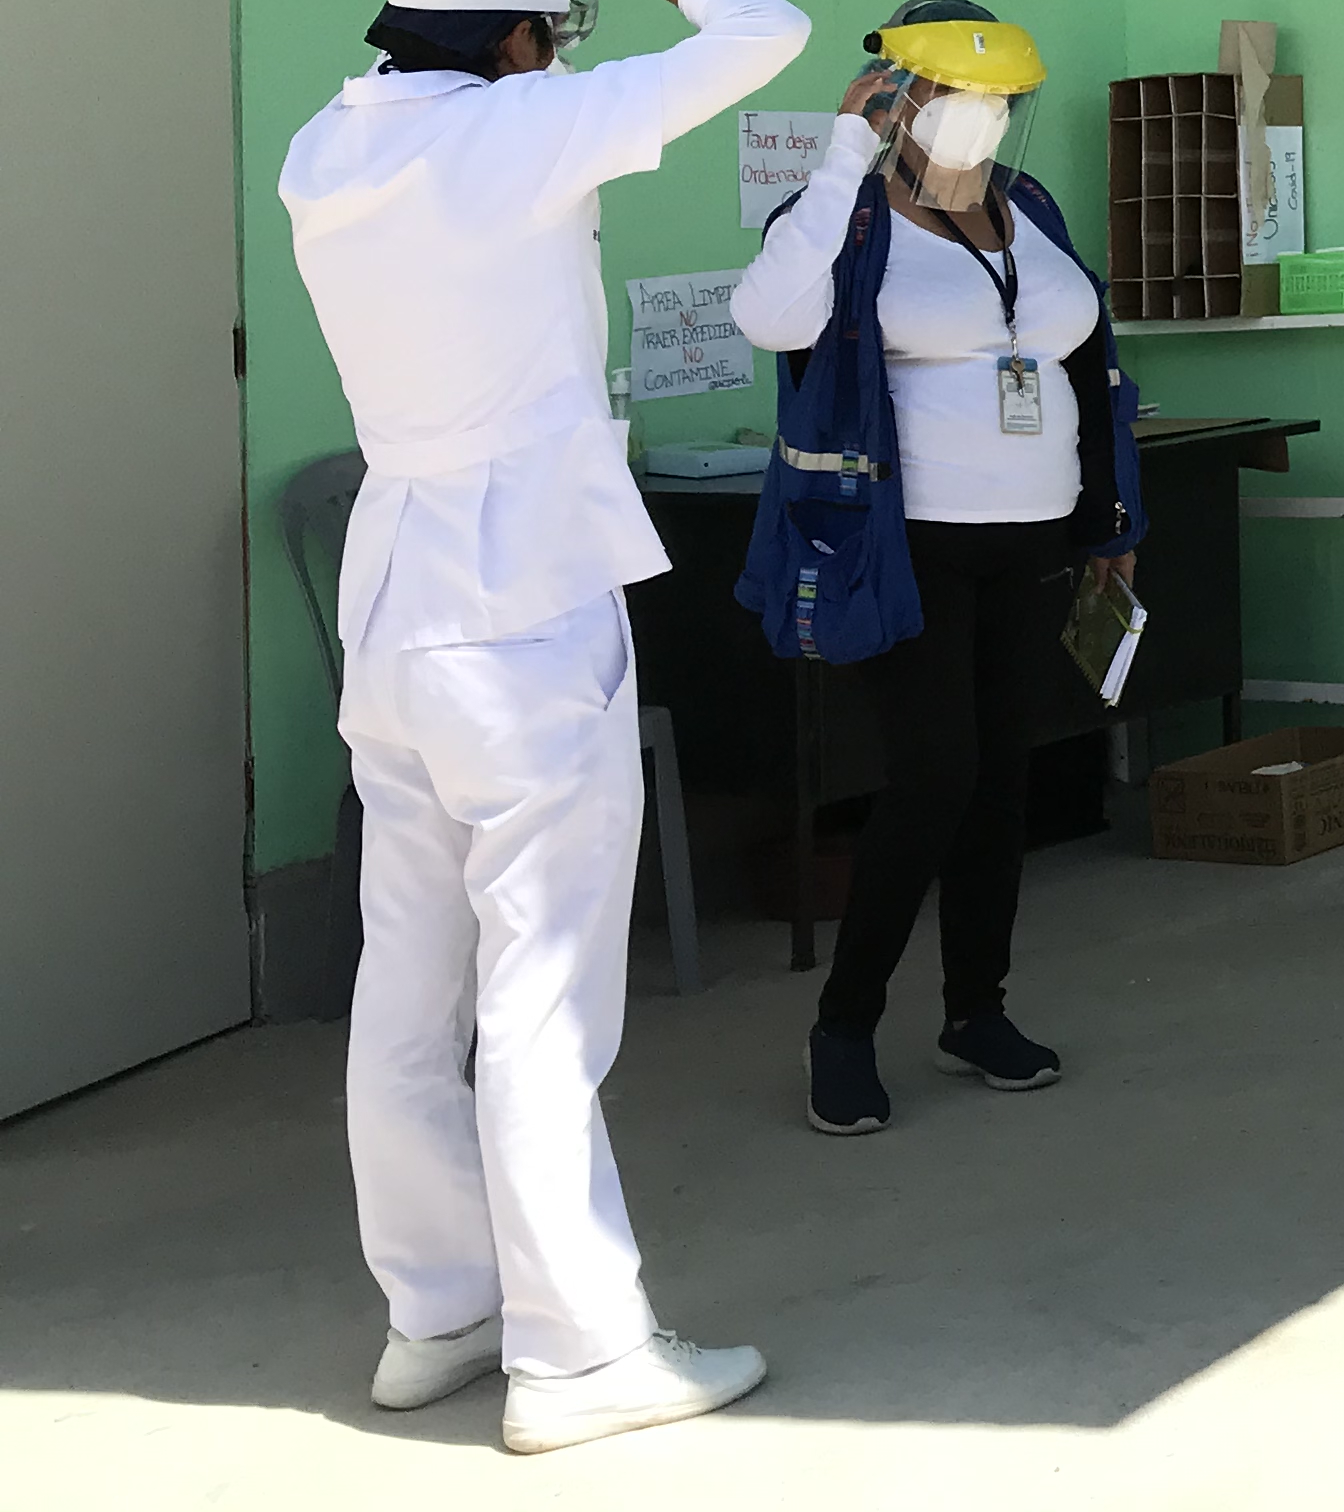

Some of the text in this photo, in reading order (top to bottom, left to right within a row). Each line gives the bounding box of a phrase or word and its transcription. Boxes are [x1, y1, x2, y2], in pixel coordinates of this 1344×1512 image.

[742, 112, 818, 159] Favor dejar
[688, 281, 738, 308] LIMPI
[679, 309, 698, 328] NO
[634, 326, 680, 349] TRAER
[682, 346, 704, 364] NO
[643, 359, 735, 391] CONTAMINE
